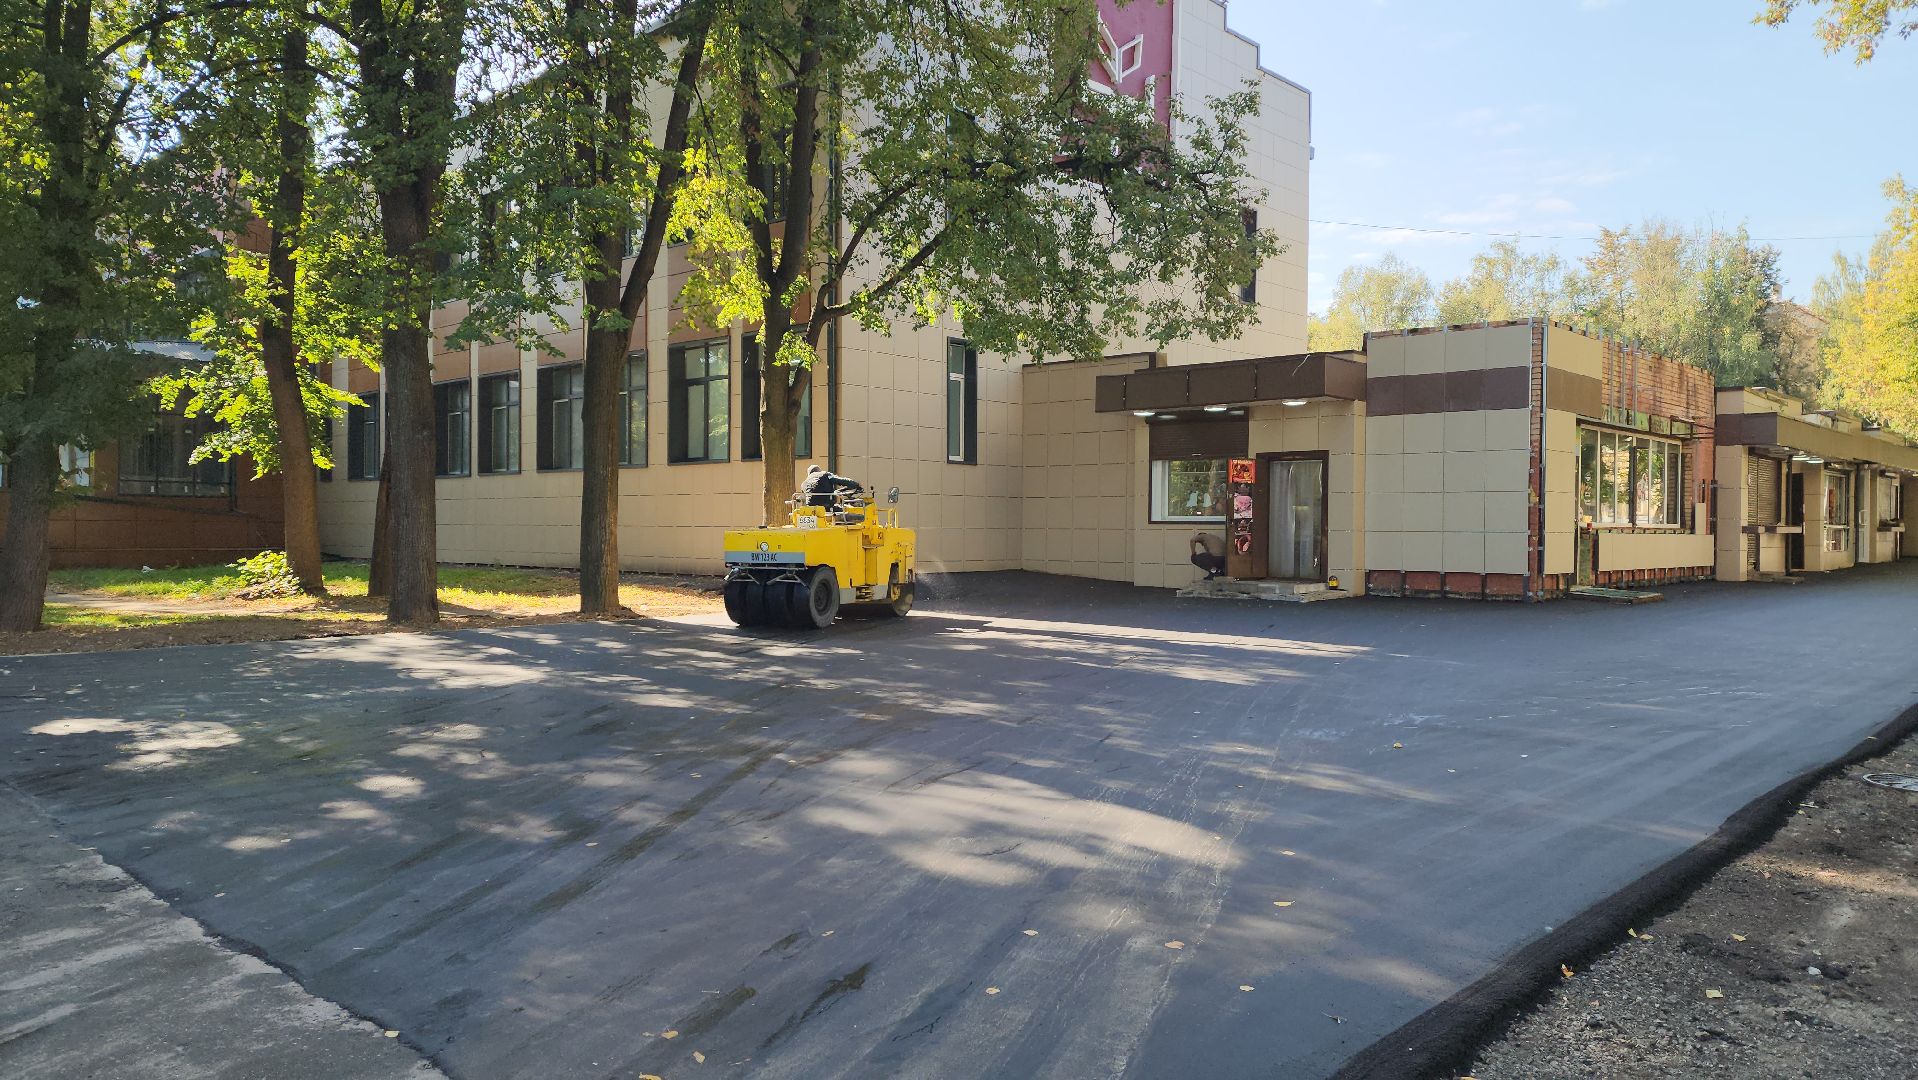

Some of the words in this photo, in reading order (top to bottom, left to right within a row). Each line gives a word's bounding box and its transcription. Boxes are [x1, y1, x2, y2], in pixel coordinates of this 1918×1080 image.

[751, 553, 760, 561] BW
[761, 553, 769, 561] 123
[770, 553, 777, 561] AC
